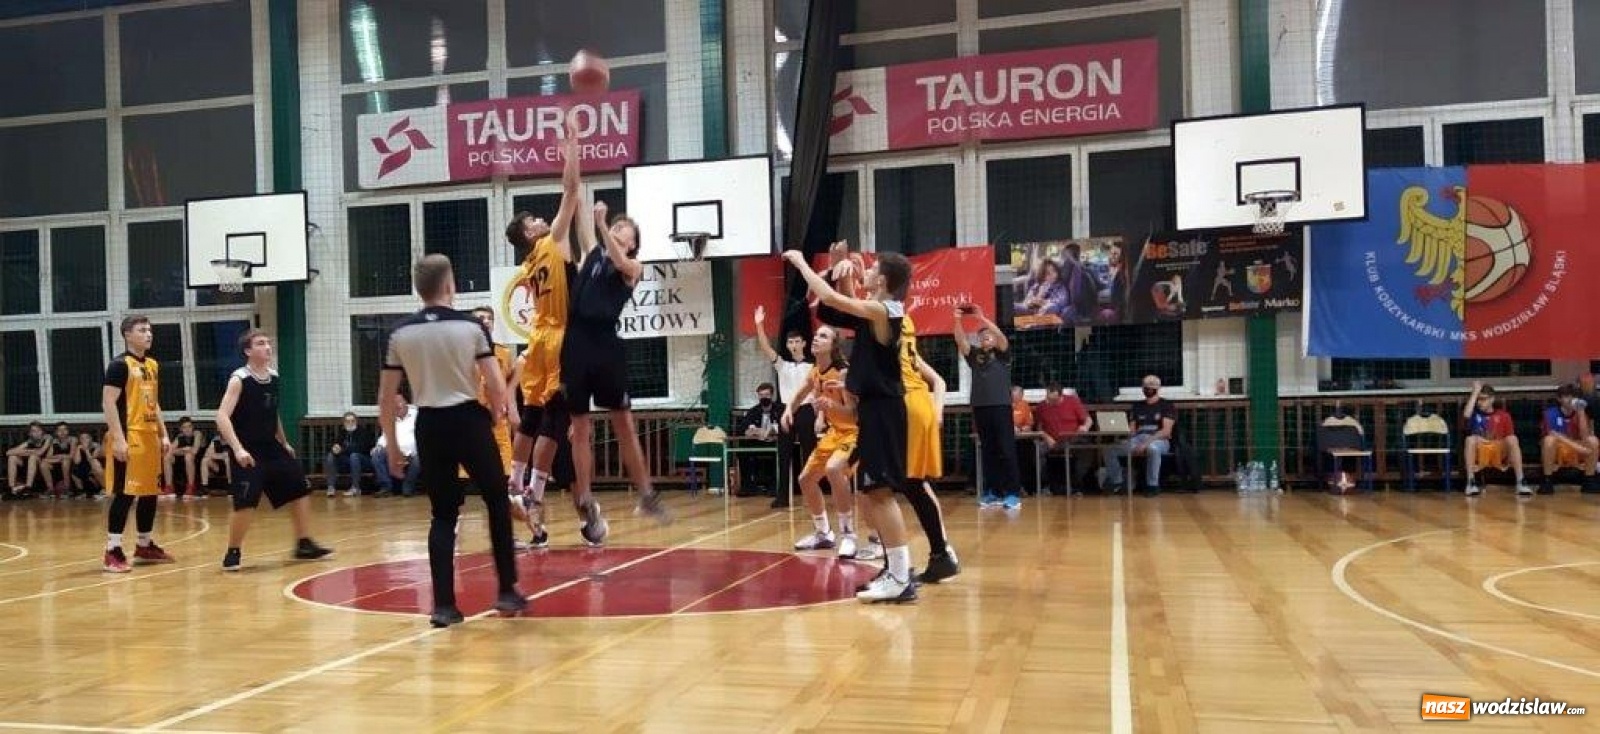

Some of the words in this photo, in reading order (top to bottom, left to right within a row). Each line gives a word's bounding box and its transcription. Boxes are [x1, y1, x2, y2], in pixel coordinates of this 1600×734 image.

[916, 58, 1122, 111] TAURON
[457, 101, 629, 146] TAURON
[928, 110, 1013, 134] POLSKA
[1020, 103, 1121, 126] ENERGIA
[468, 148, 539, 168] POLSKA
[1363, 251, 1380, 283] KLUB
[1374, 285, 1446, 340] KOSZYKARSKI
[1449, 330, 1478, 341] MKS
